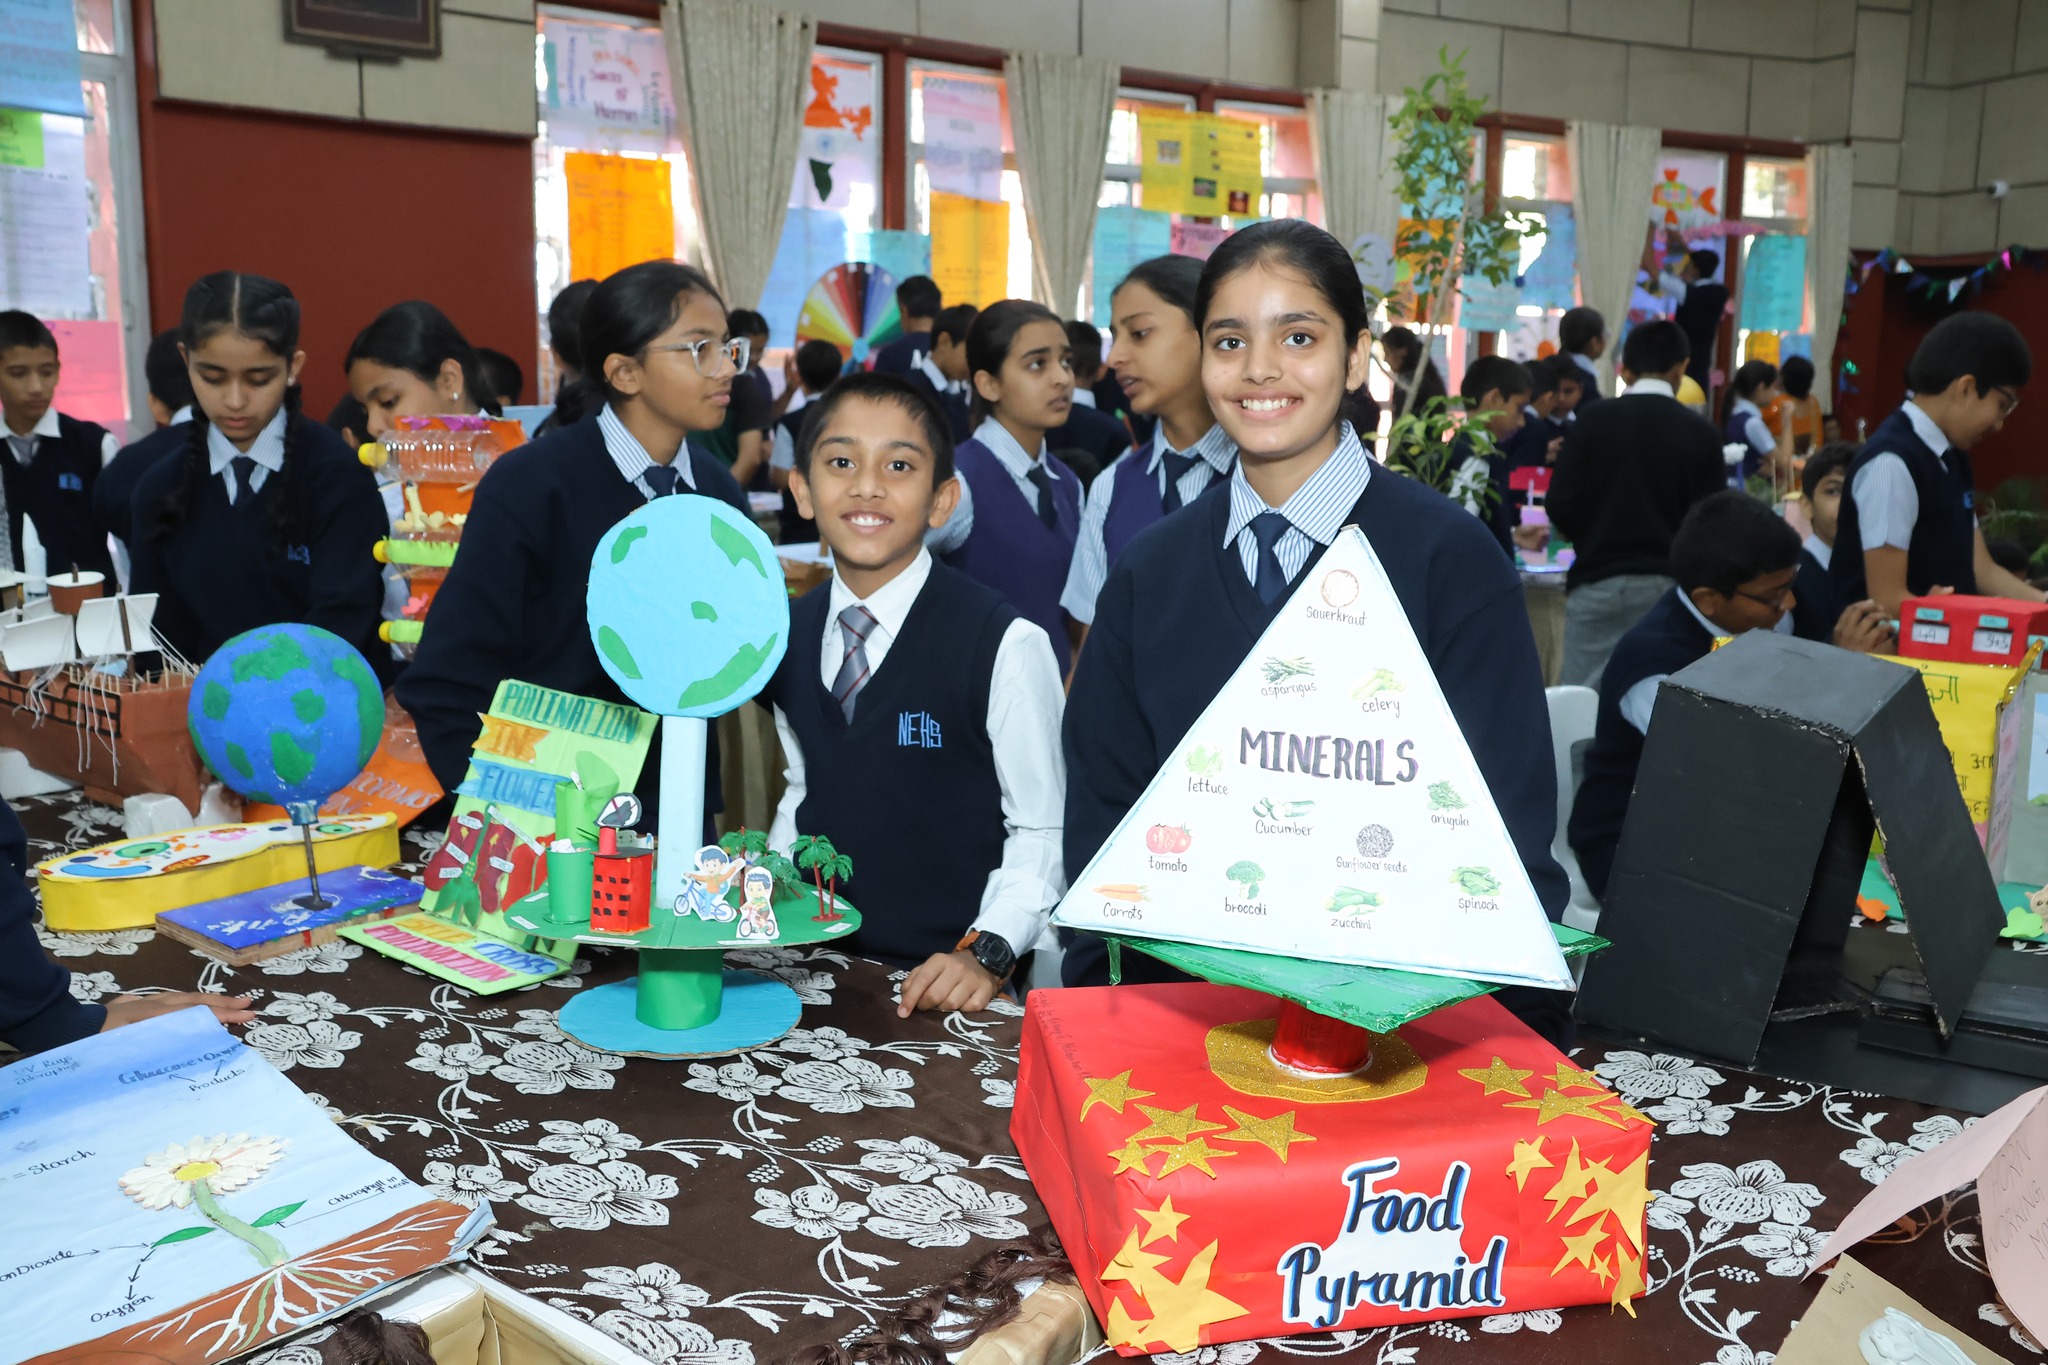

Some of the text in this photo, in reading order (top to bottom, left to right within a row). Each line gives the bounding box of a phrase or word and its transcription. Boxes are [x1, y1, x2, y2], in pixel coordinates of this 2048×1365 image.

[1306, 606, 1367, 626] Sauerkraut
[1261, 682, 1317, 699] asparagus
[501, 683, 641, 744] POLLINATION
[1362, 698, 1400, 718] celery
[490, 723, 530, 757] IN
[1240, 727, 1418, 785] MINERALS
[1188, 777, 1229, 795] lettuce
[1255, 819, 1314, 836] Cucumber
[1431, 814, 1470, 830] arugula
[1148, 856, 1188, 873] tomato
[1336, 856, 1381, 873] Sunflower
[1224, 897, 1267, 916] broccoli
[473, 942, 559, 975] CROSS
[43, 1055, 73, 1070] Rays
[28, 1150, 96, 1175] Starch
[1346, 1160, 1463, 1234] Food
[1282, 1239, 1506, 1328] Pyramid
[90, 1295, 154, 1323] Oxygen
